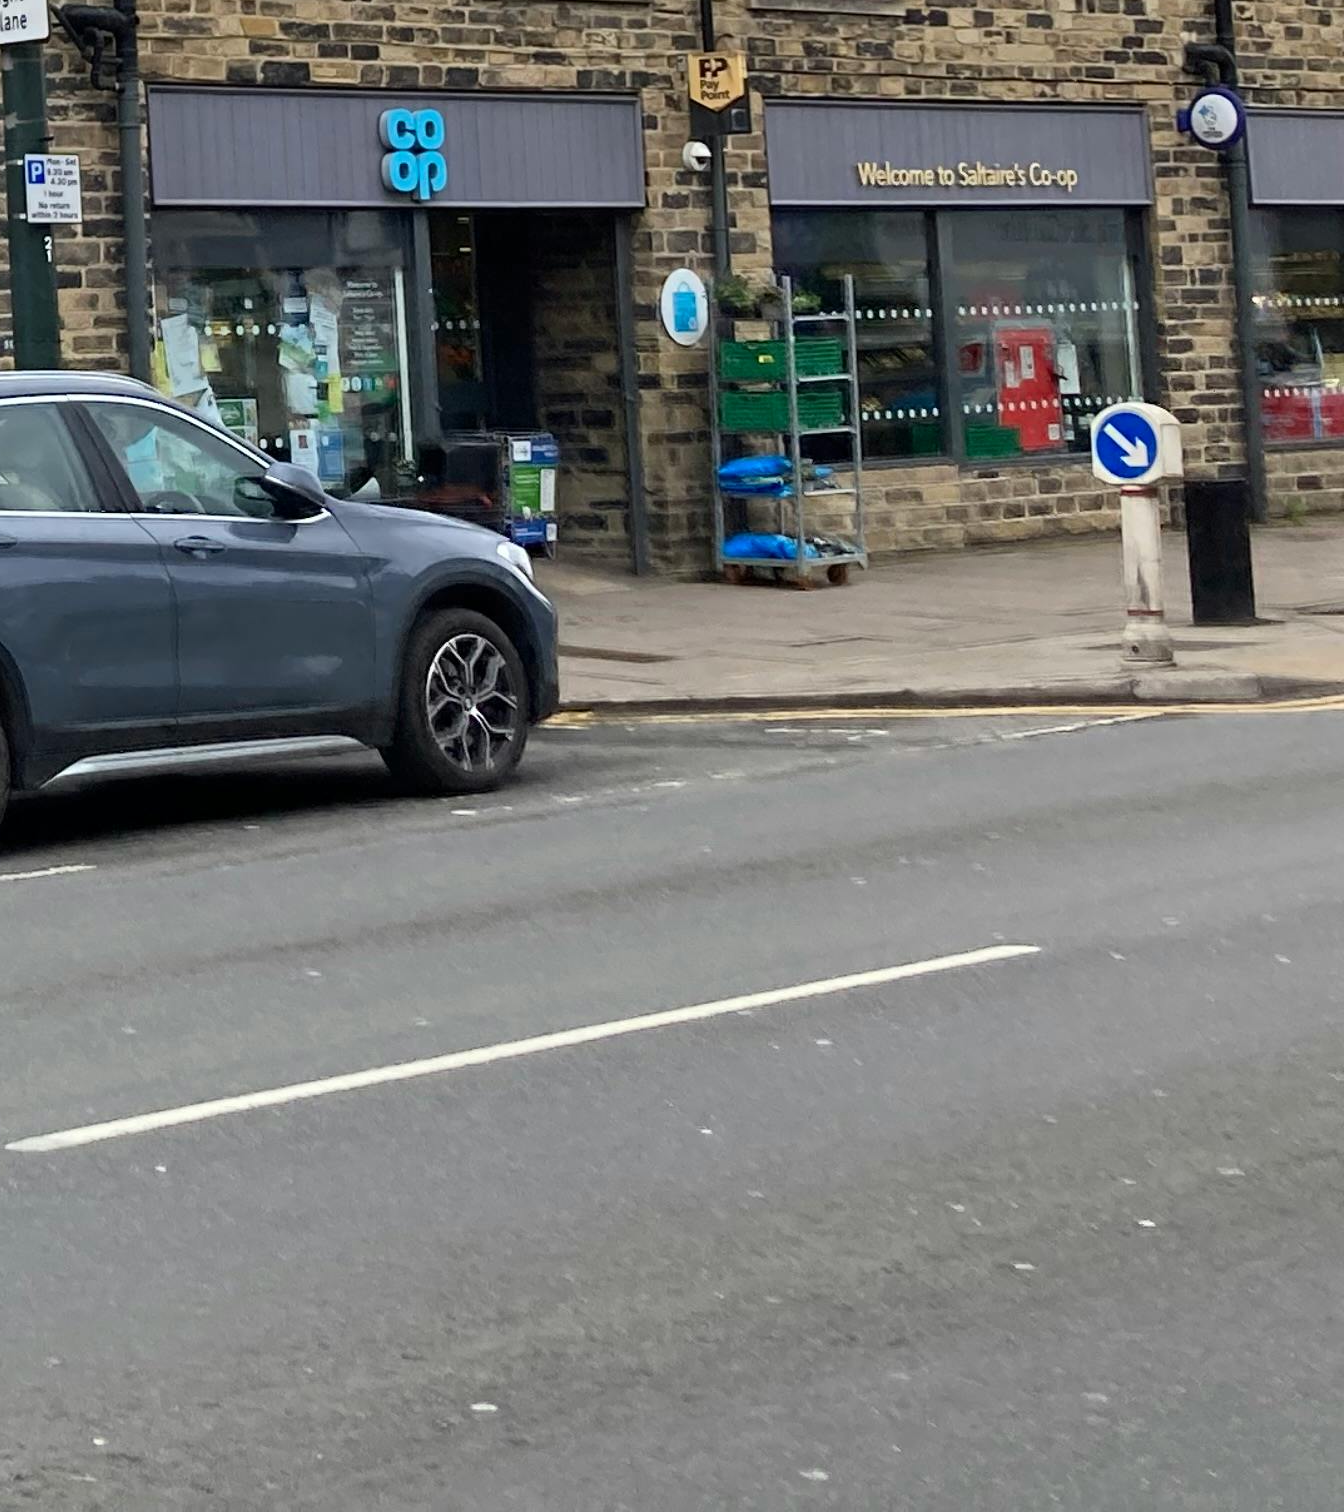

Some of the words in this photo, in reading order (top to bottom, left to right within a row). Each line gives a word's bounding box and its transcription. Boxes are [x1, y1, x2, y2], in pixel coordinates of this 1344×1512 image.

[0, 11, 28, 32] lane
[700, 79, 719, 91] Pay
[700, 90, 730, 100] Point
[857, 161, 934, 186] Welcome
[937, 164, 955, 186] to
[957, 161, 1026, 186] Saltaire's
[1029, 162, 1078, 192] Co-op
[38, 201, 48, 209] No
[59, 211, 78, 219] hours
